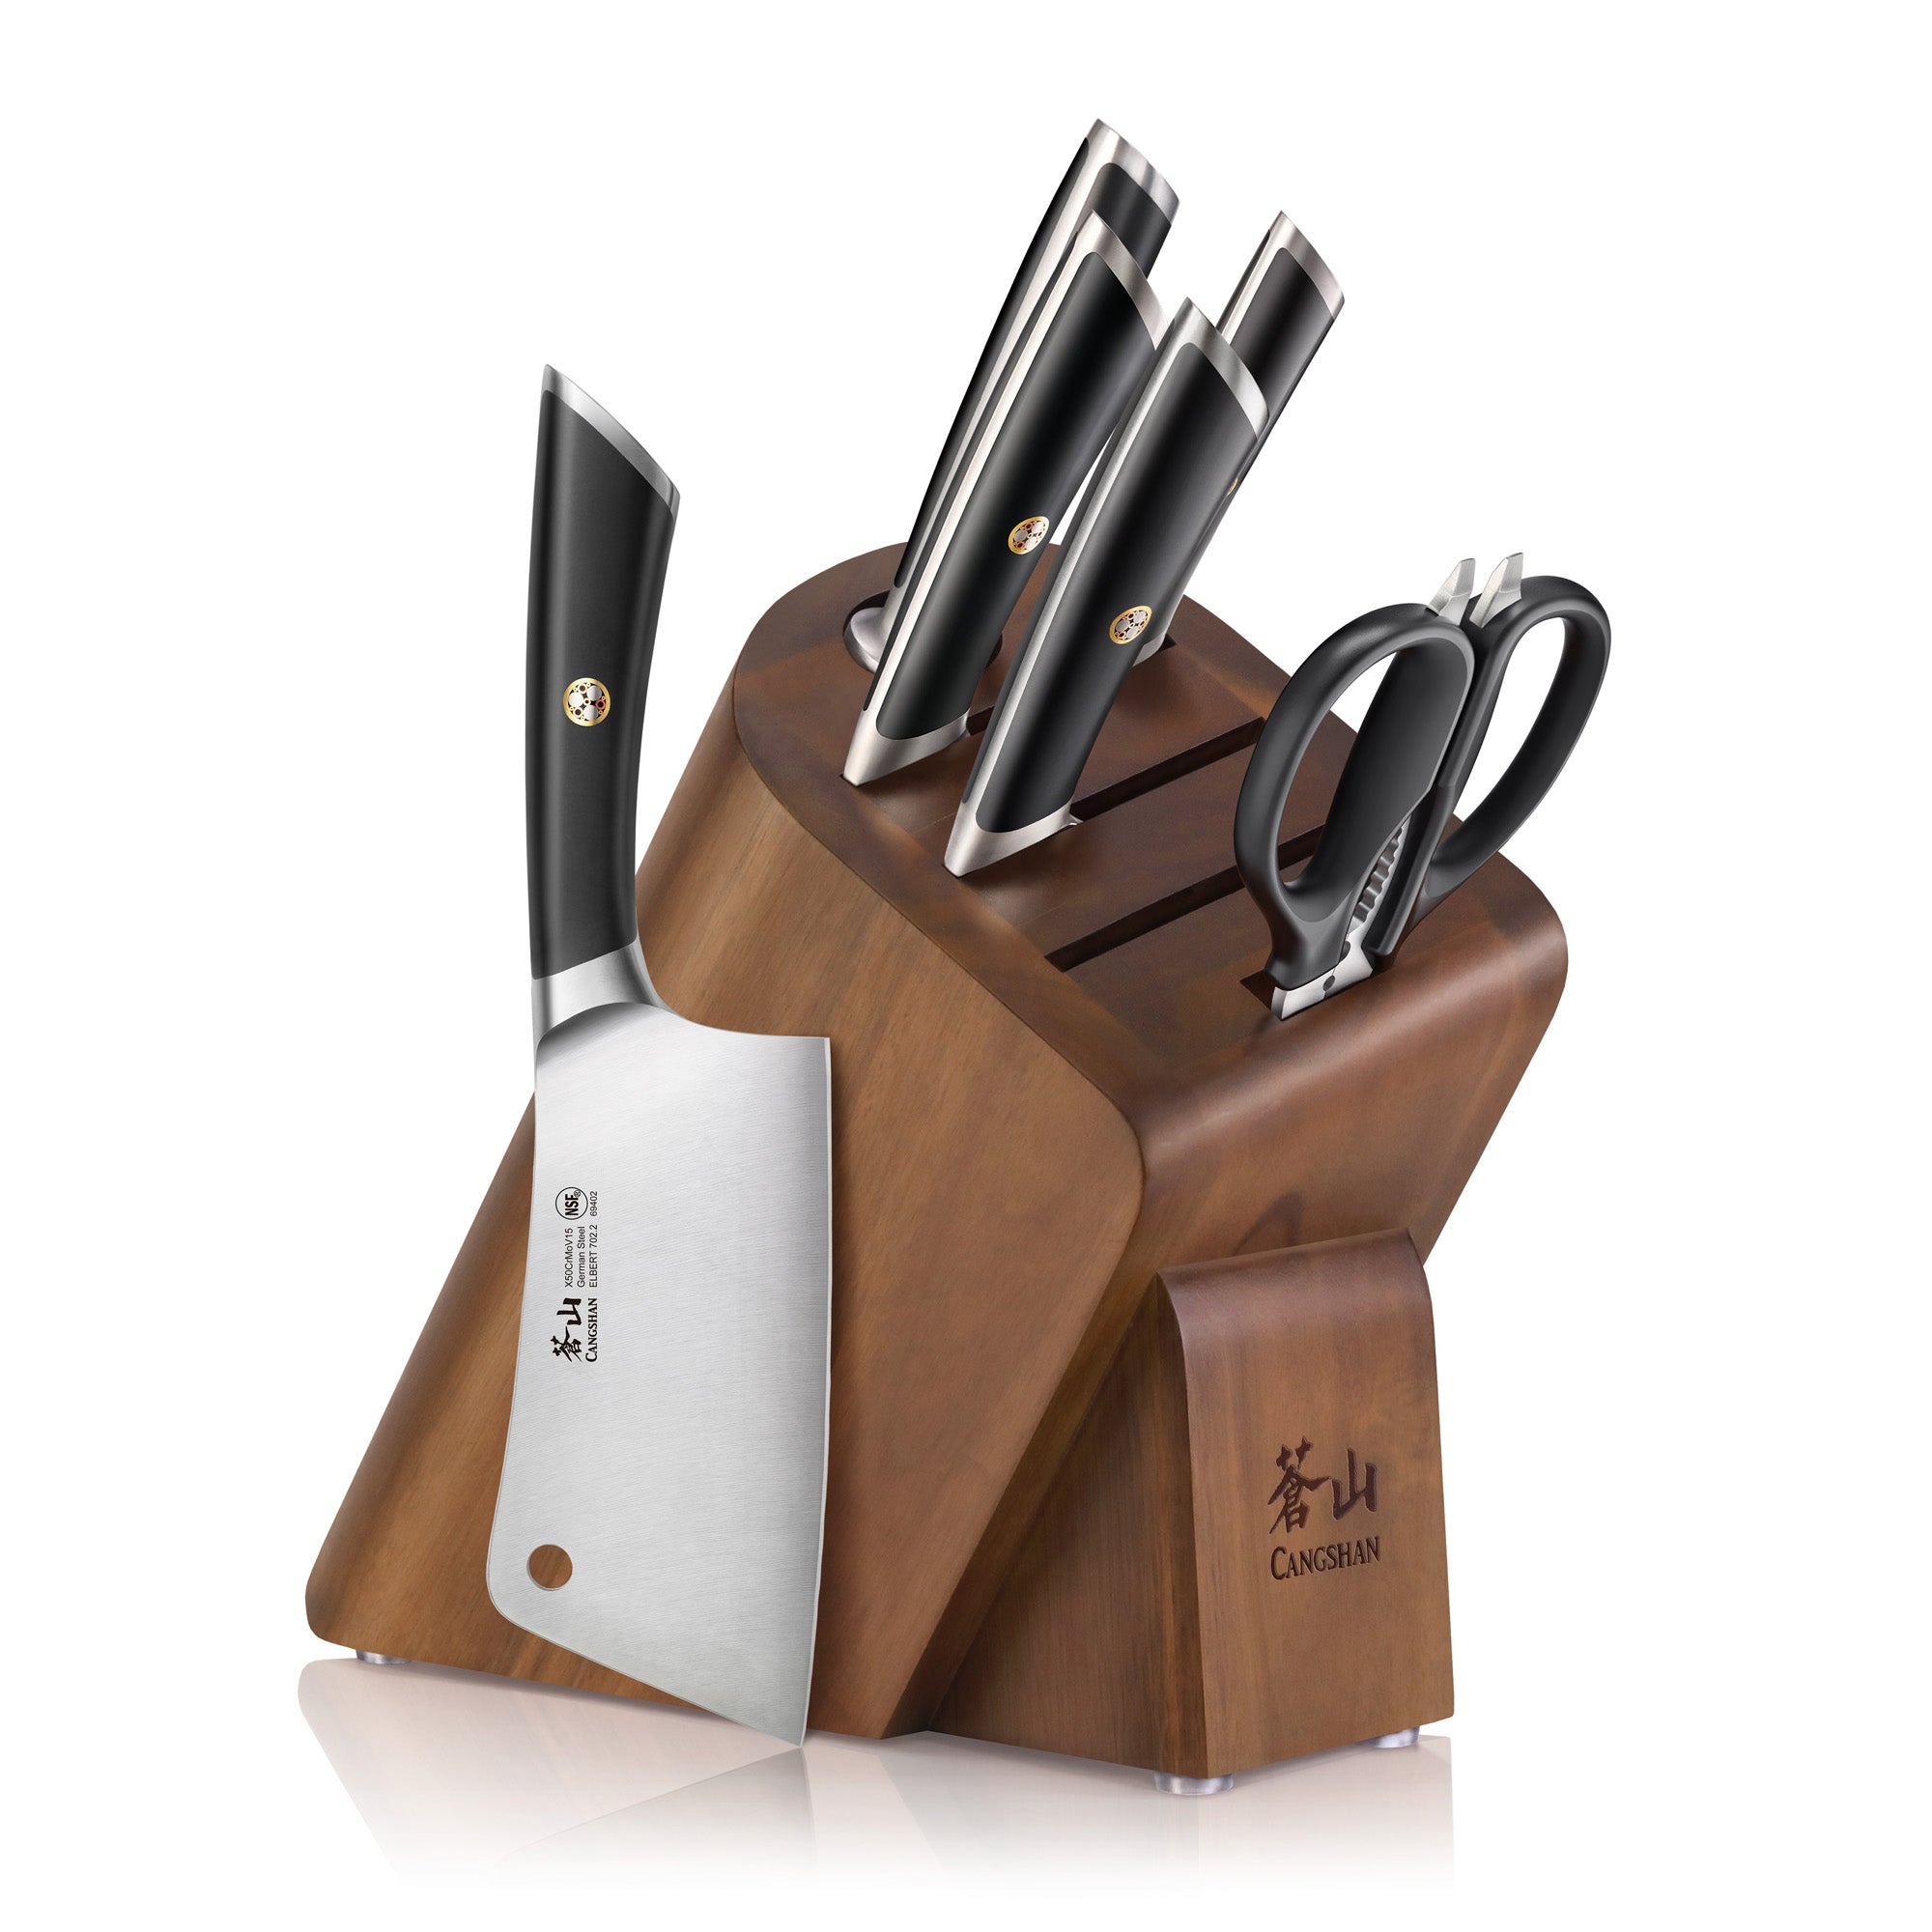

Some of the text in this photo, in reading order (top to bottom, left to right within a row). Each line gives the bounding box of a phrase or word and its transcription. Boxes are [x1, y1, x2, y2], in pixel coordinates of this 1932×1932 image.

[577, 1226, 585, 1288] German Steel
[589, 1190, 598, 1288] ELBERT 702.2 69402
[551, 1297, 582, 1362] 蒼山
[585, 1298, 598, 1362] CANGSHAN
[1267, 1435, 1378, 1535] 蒼山
[1270, 1536, 1381, 1580] CANGSHAN
